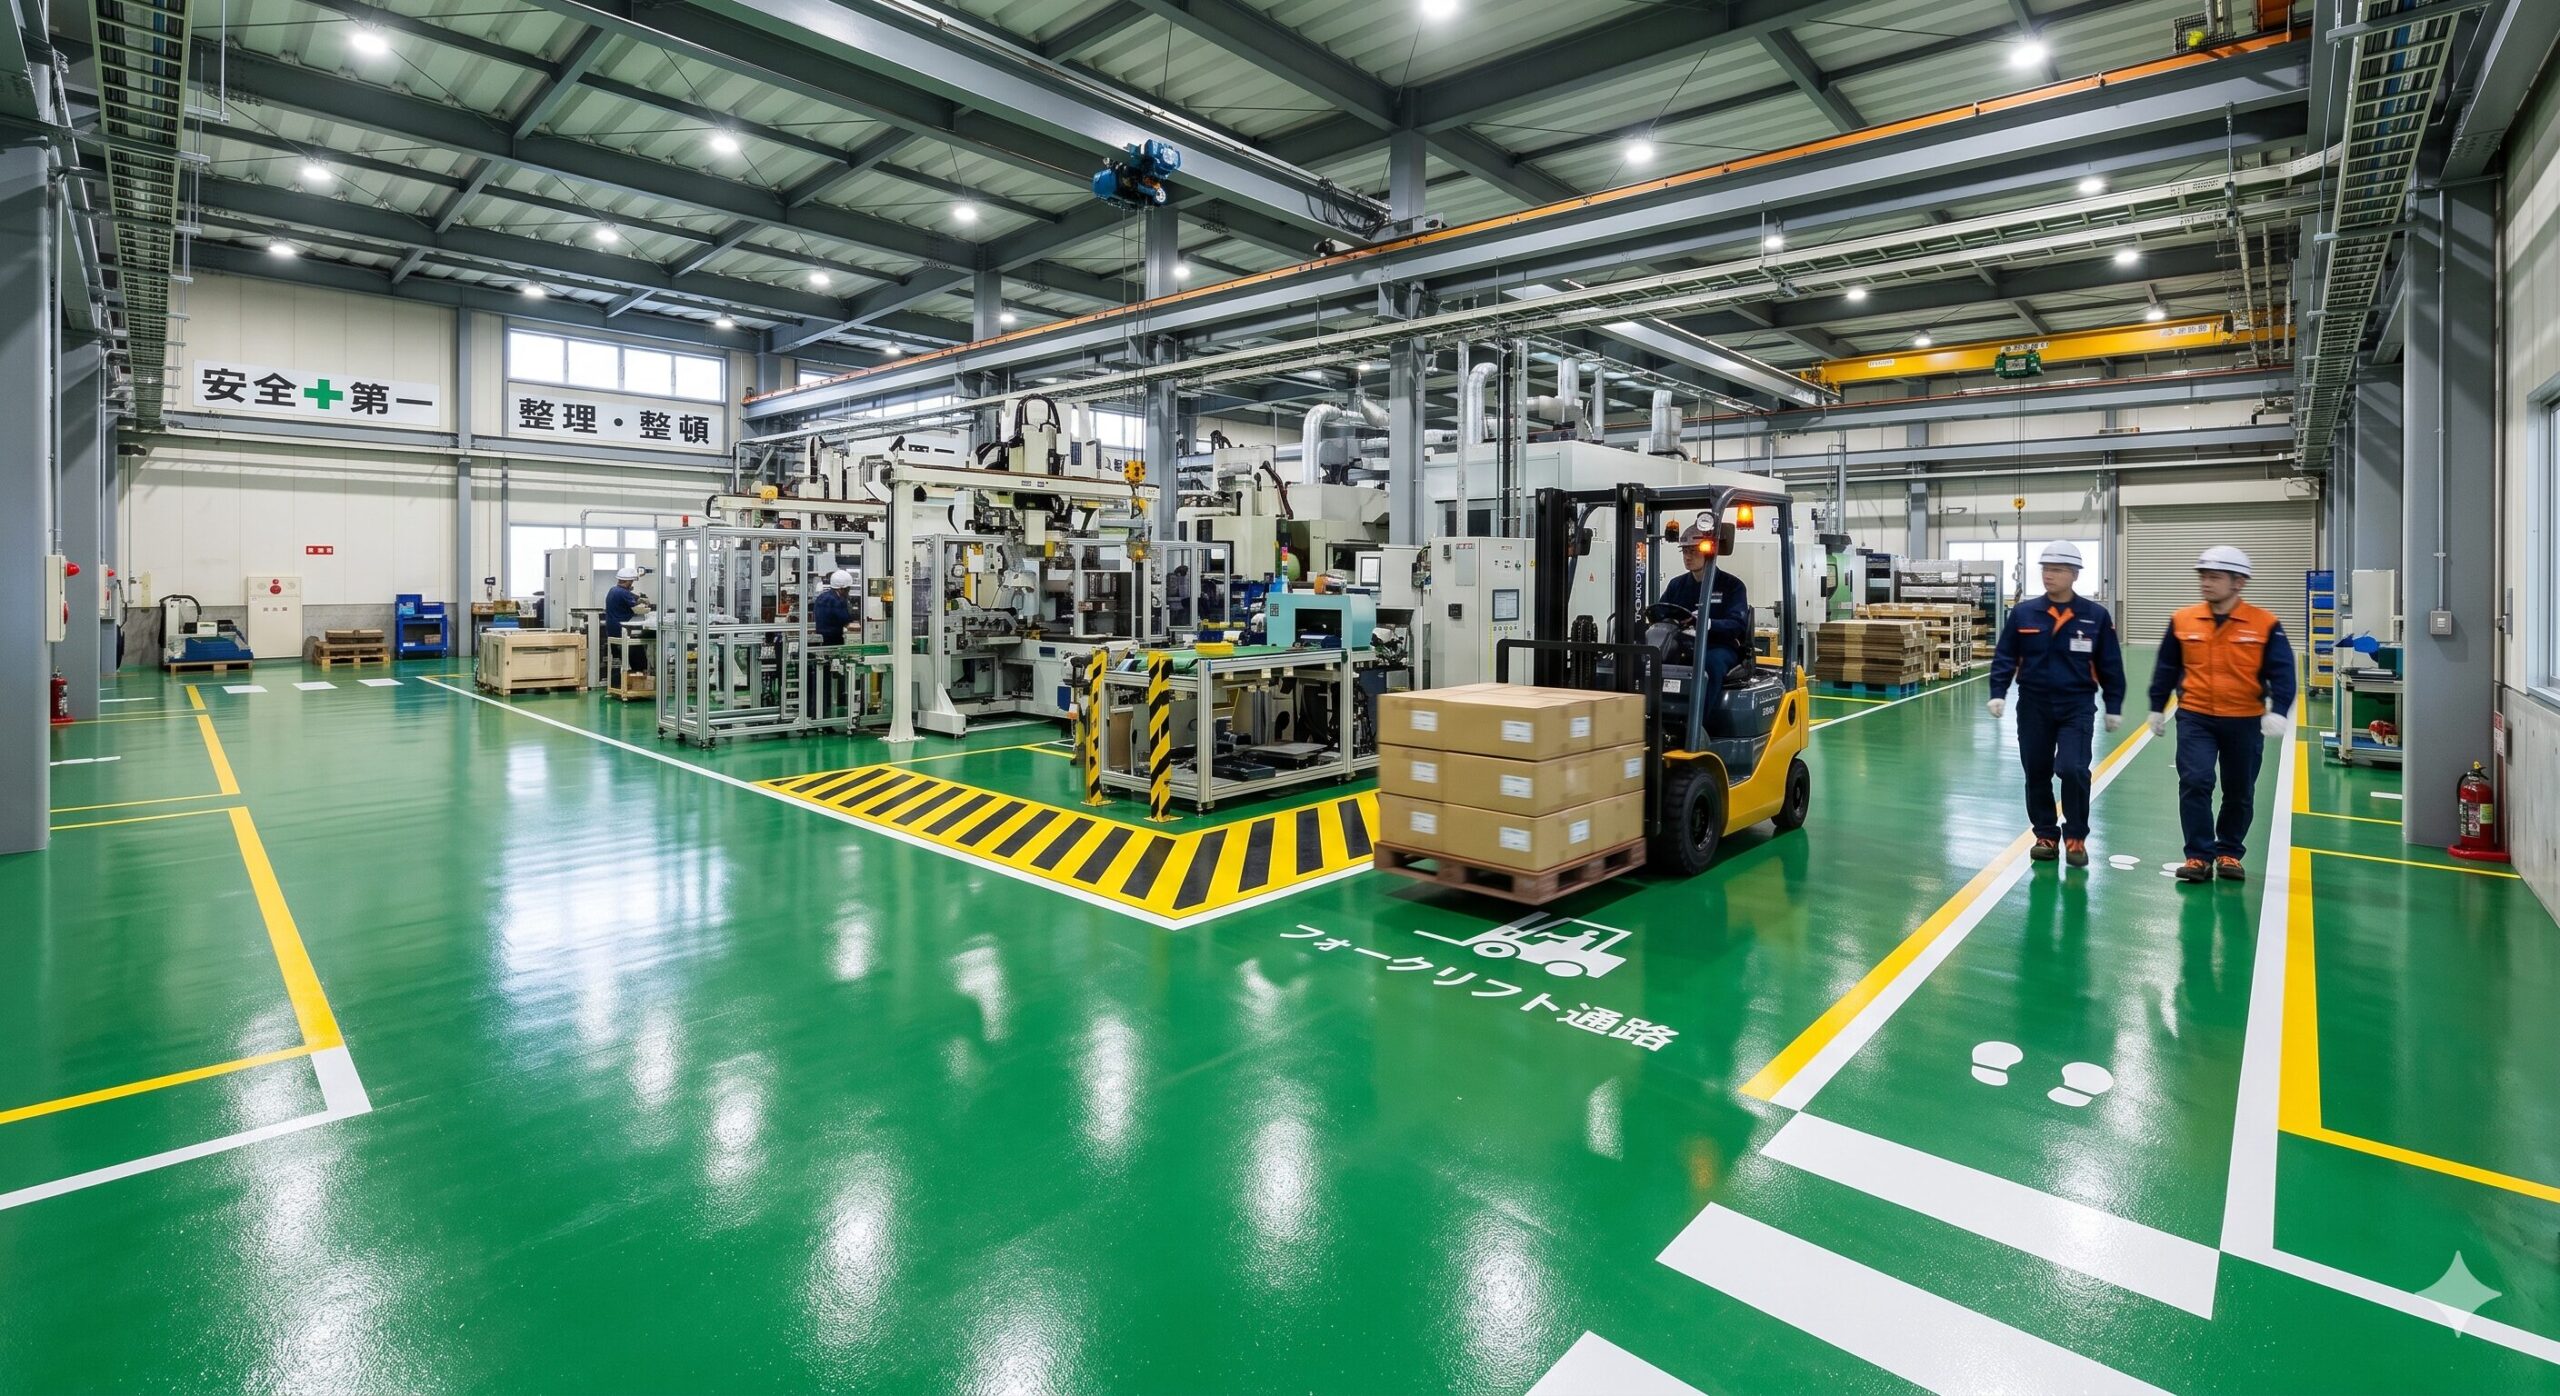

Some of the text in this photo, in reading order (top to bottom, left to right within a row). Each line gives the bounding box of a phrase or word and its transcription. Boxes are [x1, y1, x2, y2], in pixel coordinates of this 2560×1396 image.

[202, 368, 433, 415] 安全 第一
[1279, 924, 1680, 1052] フォークリフト通路
